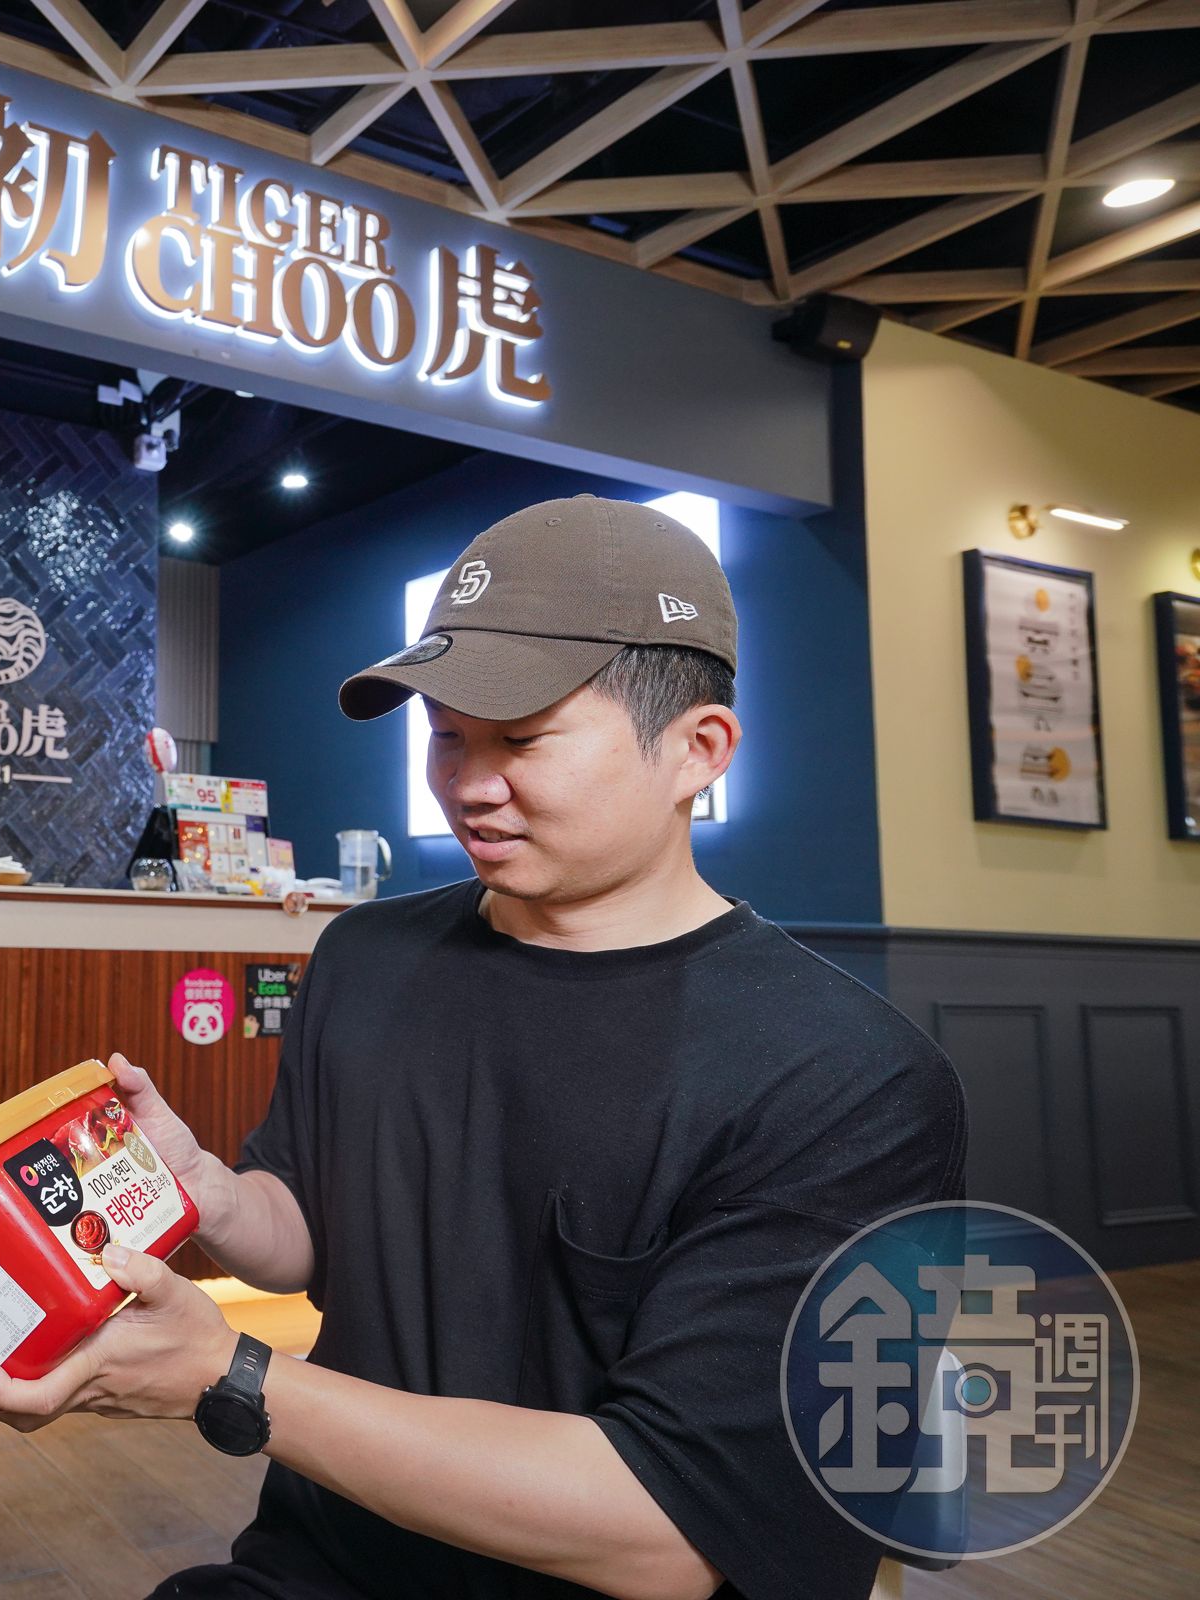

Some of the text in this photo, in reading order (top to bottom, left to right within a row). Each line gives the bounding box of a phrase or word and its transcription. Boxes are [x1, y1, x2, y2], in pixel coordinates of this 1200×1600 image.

[150, 145, 397, 277] TIGER
[125, 212, 416, 372] CHOO
[416, 244, 552, 408] 虎
[16, 704, 70, 760] 虎
[197, 788, 217, 803] 95
[258, 969, 287, 982] Uber
[258, 982, 287, 996] Eats
[33, 1153, 60, 1176] 청정원
[40, 1173, 79, 1215] 순창
